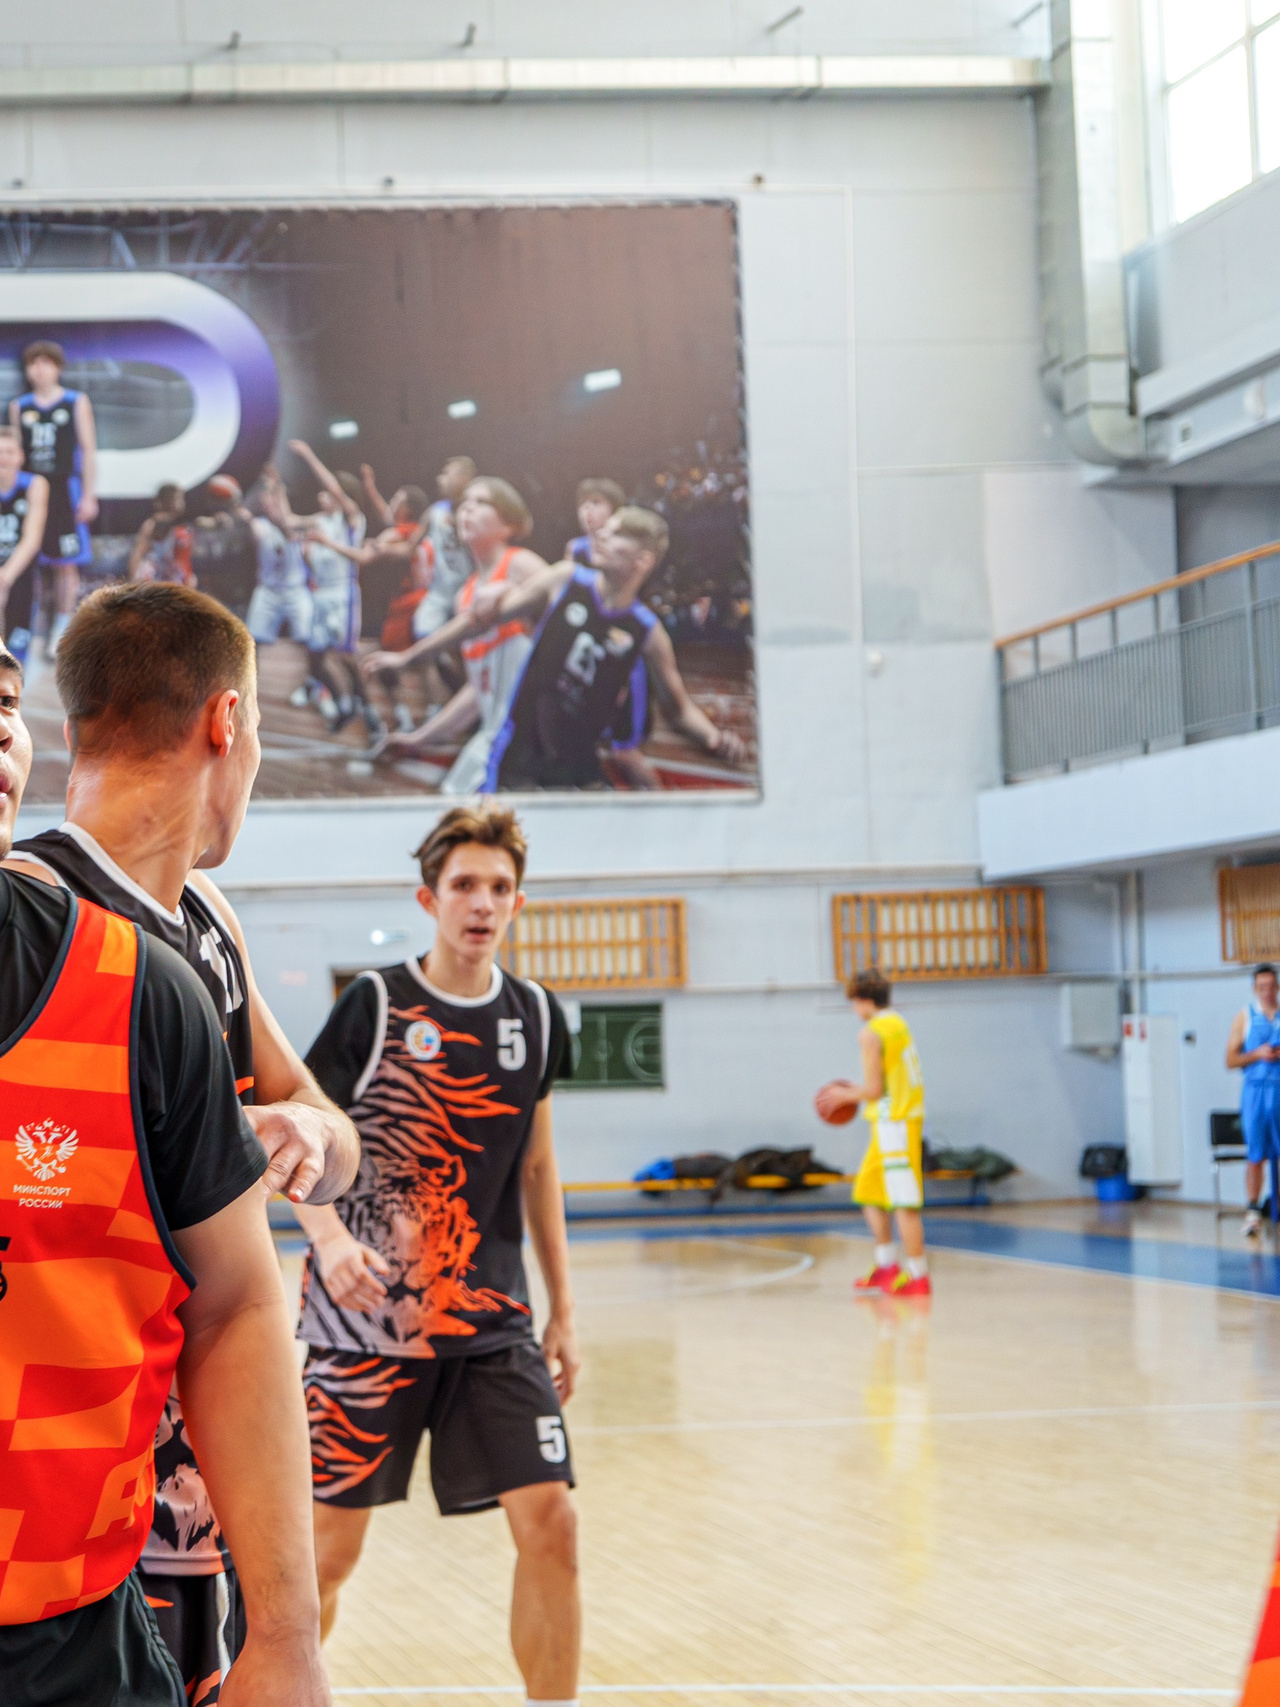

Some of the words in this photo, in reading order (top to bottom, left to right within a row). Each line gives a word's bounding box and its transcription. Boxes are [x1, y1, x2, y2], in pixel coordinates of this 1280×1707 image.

[497, 1018, 527, 1071] 5
[13, 1184, 72, 1196] МИНСПОРТ
[18, 1198, 64, 1209] РОССИИ
[535, 1415, 567, 1463] 5
